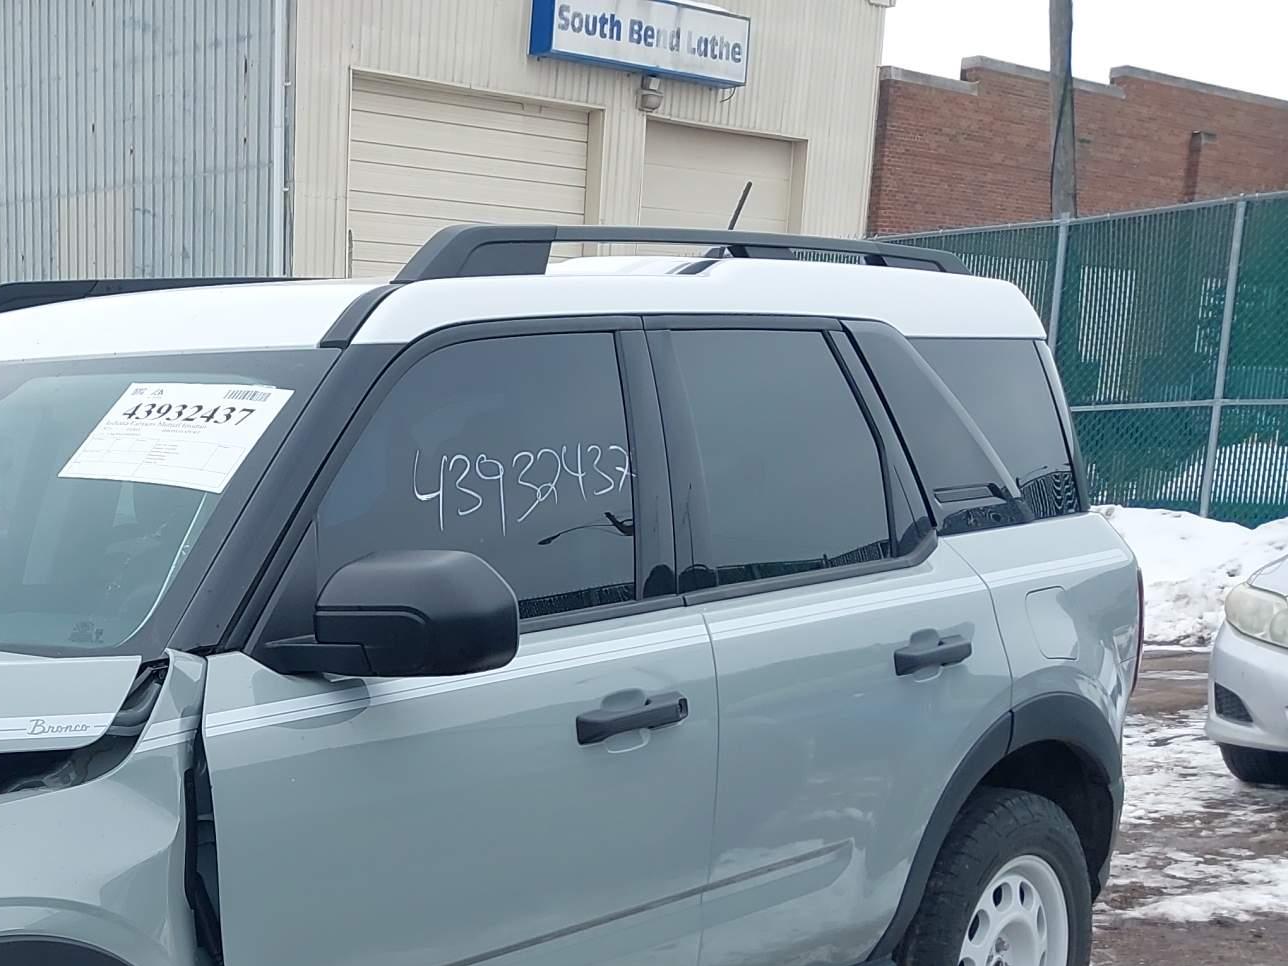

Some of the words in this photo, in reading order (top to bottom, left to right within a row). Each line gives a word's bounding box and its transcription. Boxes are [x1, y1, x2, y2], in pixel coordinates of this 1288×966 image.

[557, 4, 622, 42] South
[628, 18, 681, 52] Bend
[686, 31, 742, 63] Lathe
[121, 402, 256, 427] 43932437
[413, 442, 637, 537] 43932437
[27, 718, 90, 735] Bronco
